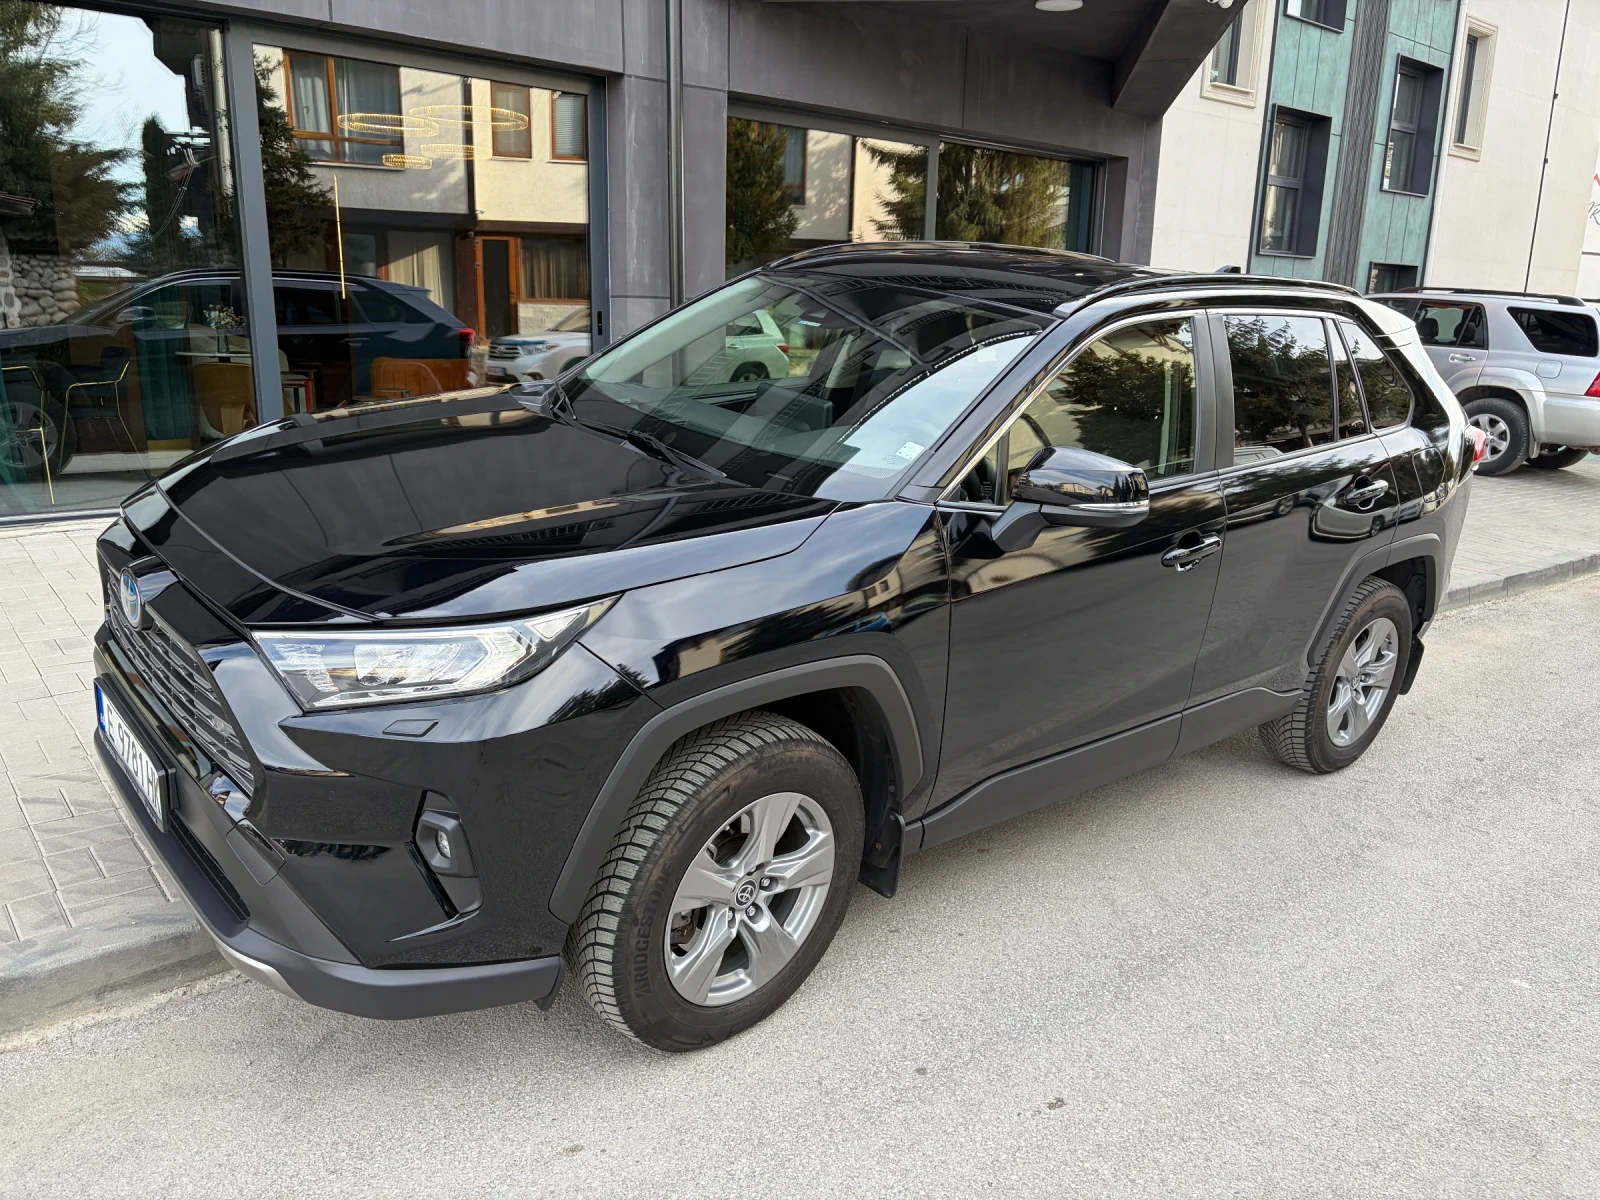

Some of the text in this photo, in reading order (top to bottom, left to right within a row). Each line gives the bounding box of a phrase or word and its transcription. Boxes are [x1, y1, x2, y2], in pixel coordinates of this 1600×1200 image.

[106, 703, 115, 743] E
[117, 721, 146, 789] 9781
[145, 759, 162, 818] HK
[633, 862, 675, 999] BRIDGESTONE
